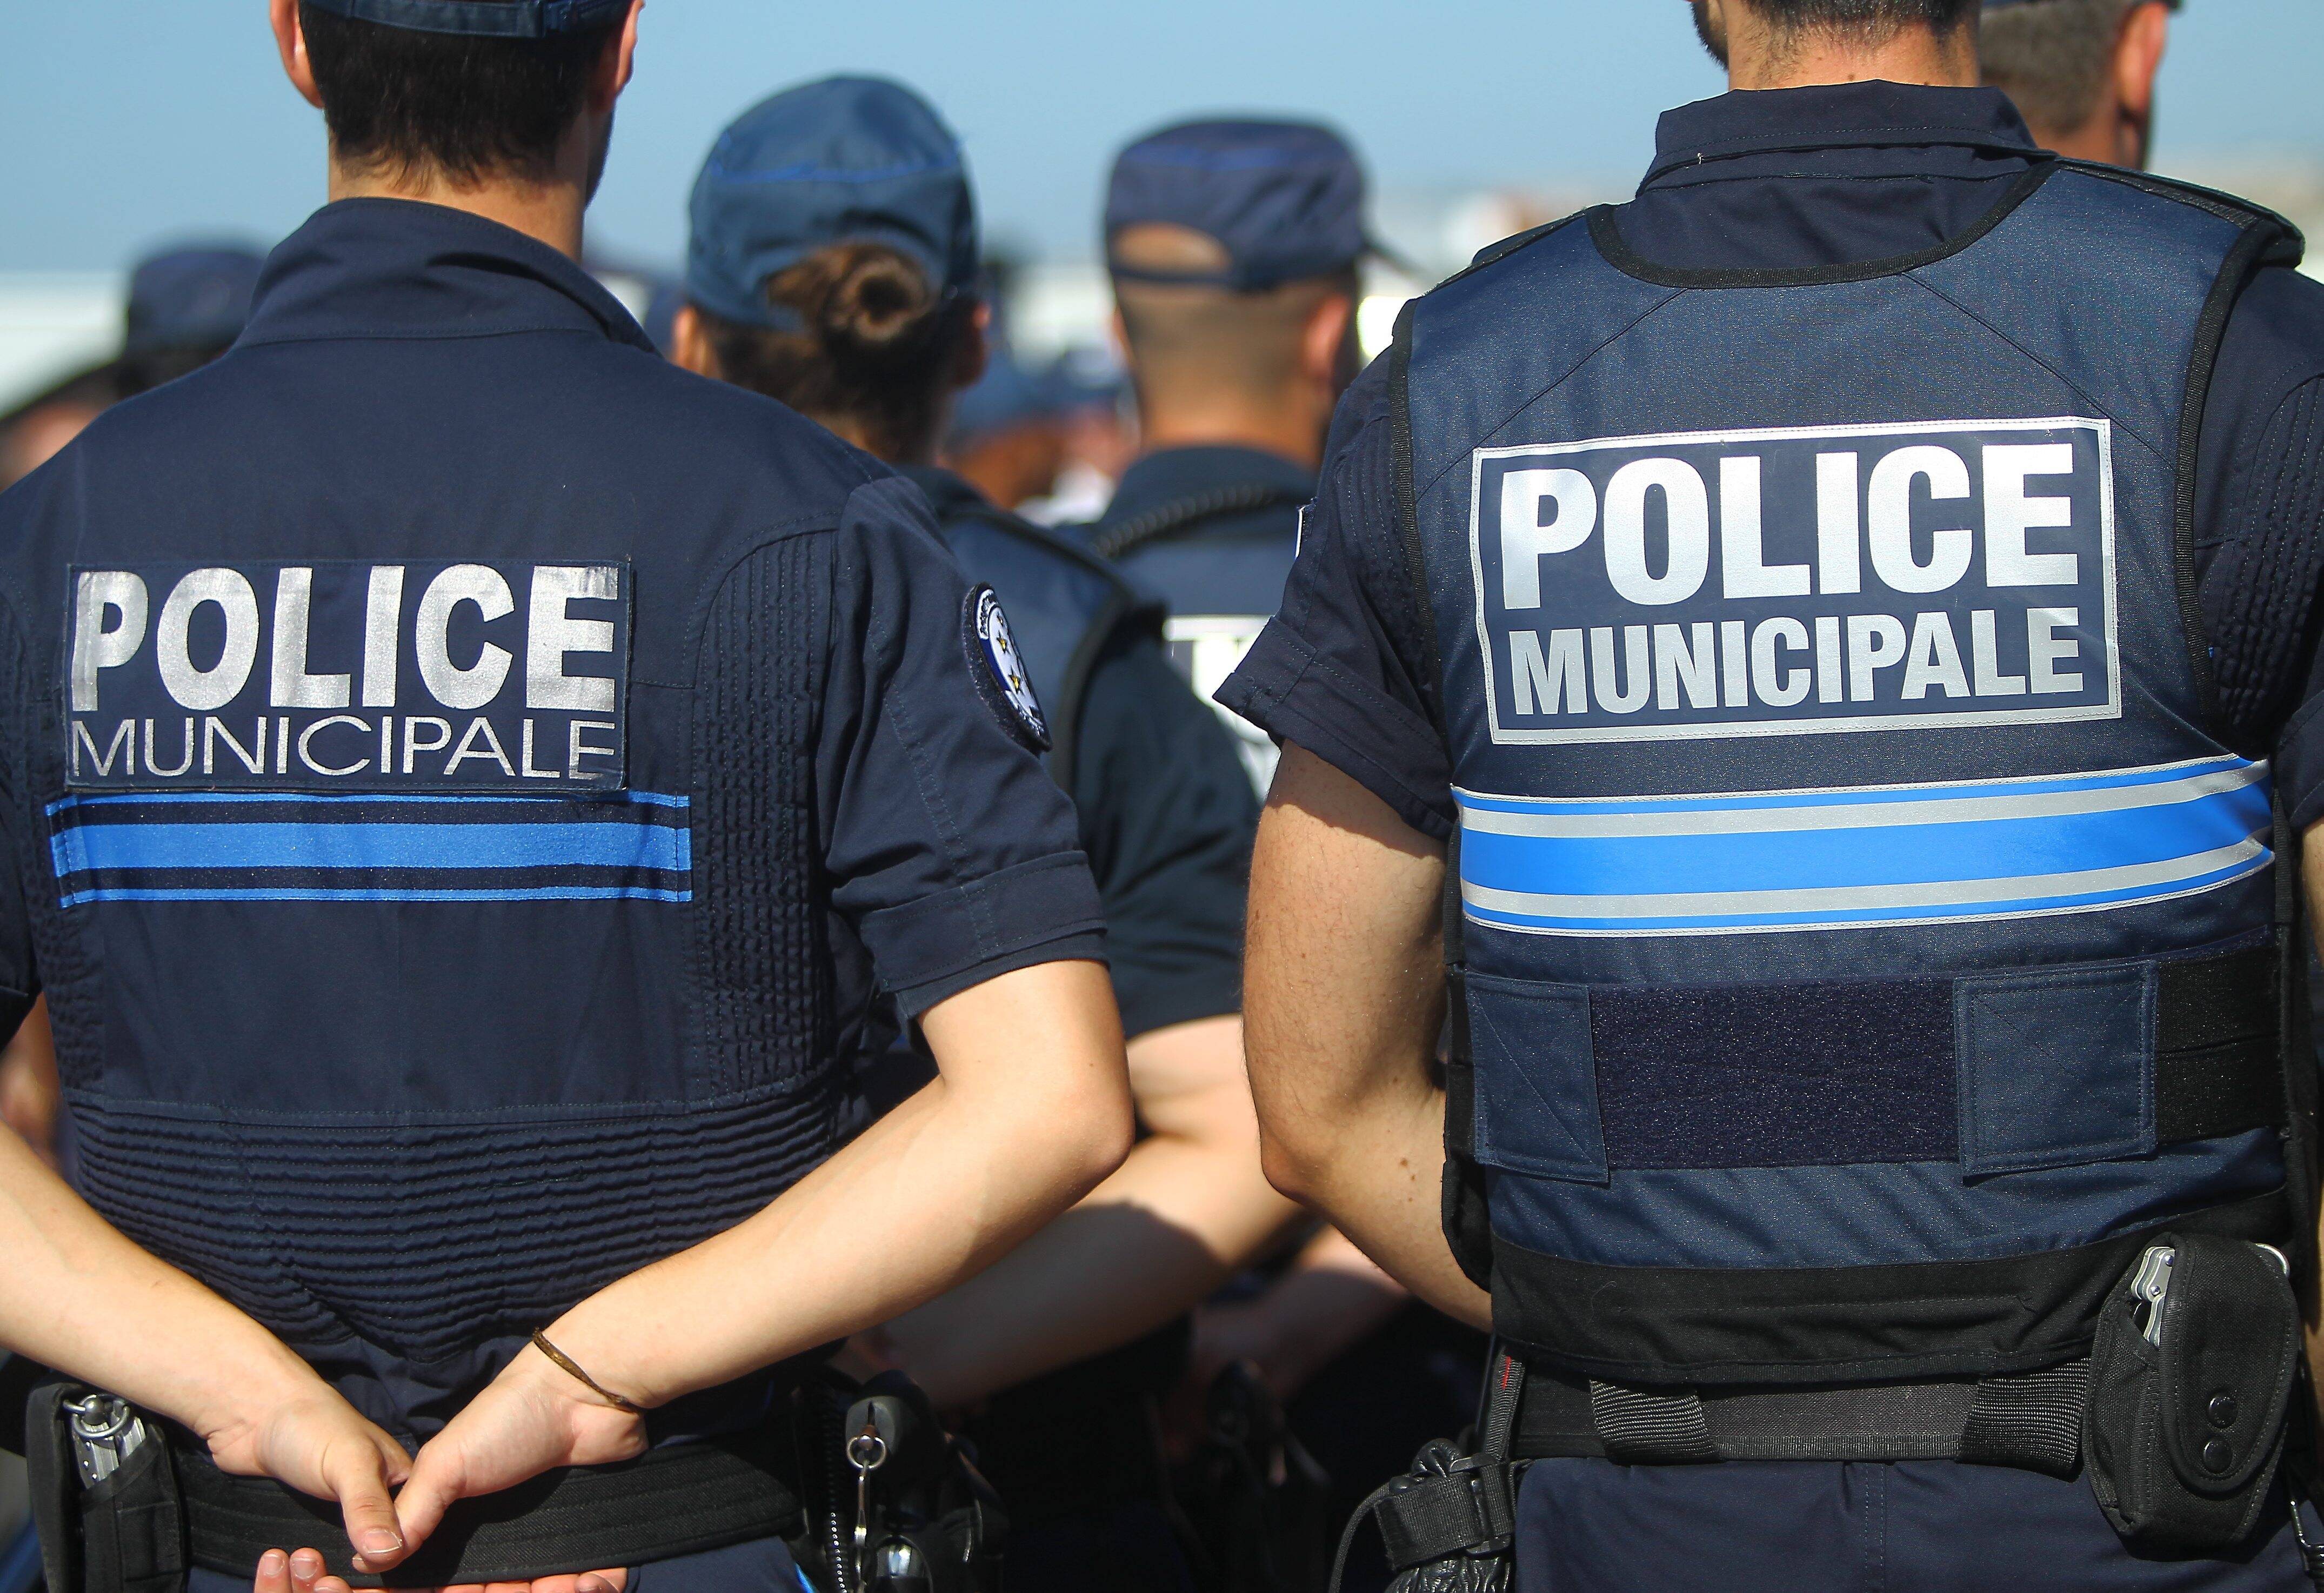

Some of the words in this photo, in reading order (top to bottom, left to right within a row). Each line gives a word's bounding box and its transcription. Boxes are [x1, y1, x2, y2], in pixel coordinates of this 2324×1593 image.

[1500, 443, 2079, 610] POLICE
[72, 564, 618, 712] POLICE
[1509, 607, 2083, 715] MUNICIPALE
[73, 715, 615, 780] MUNICIPALE
